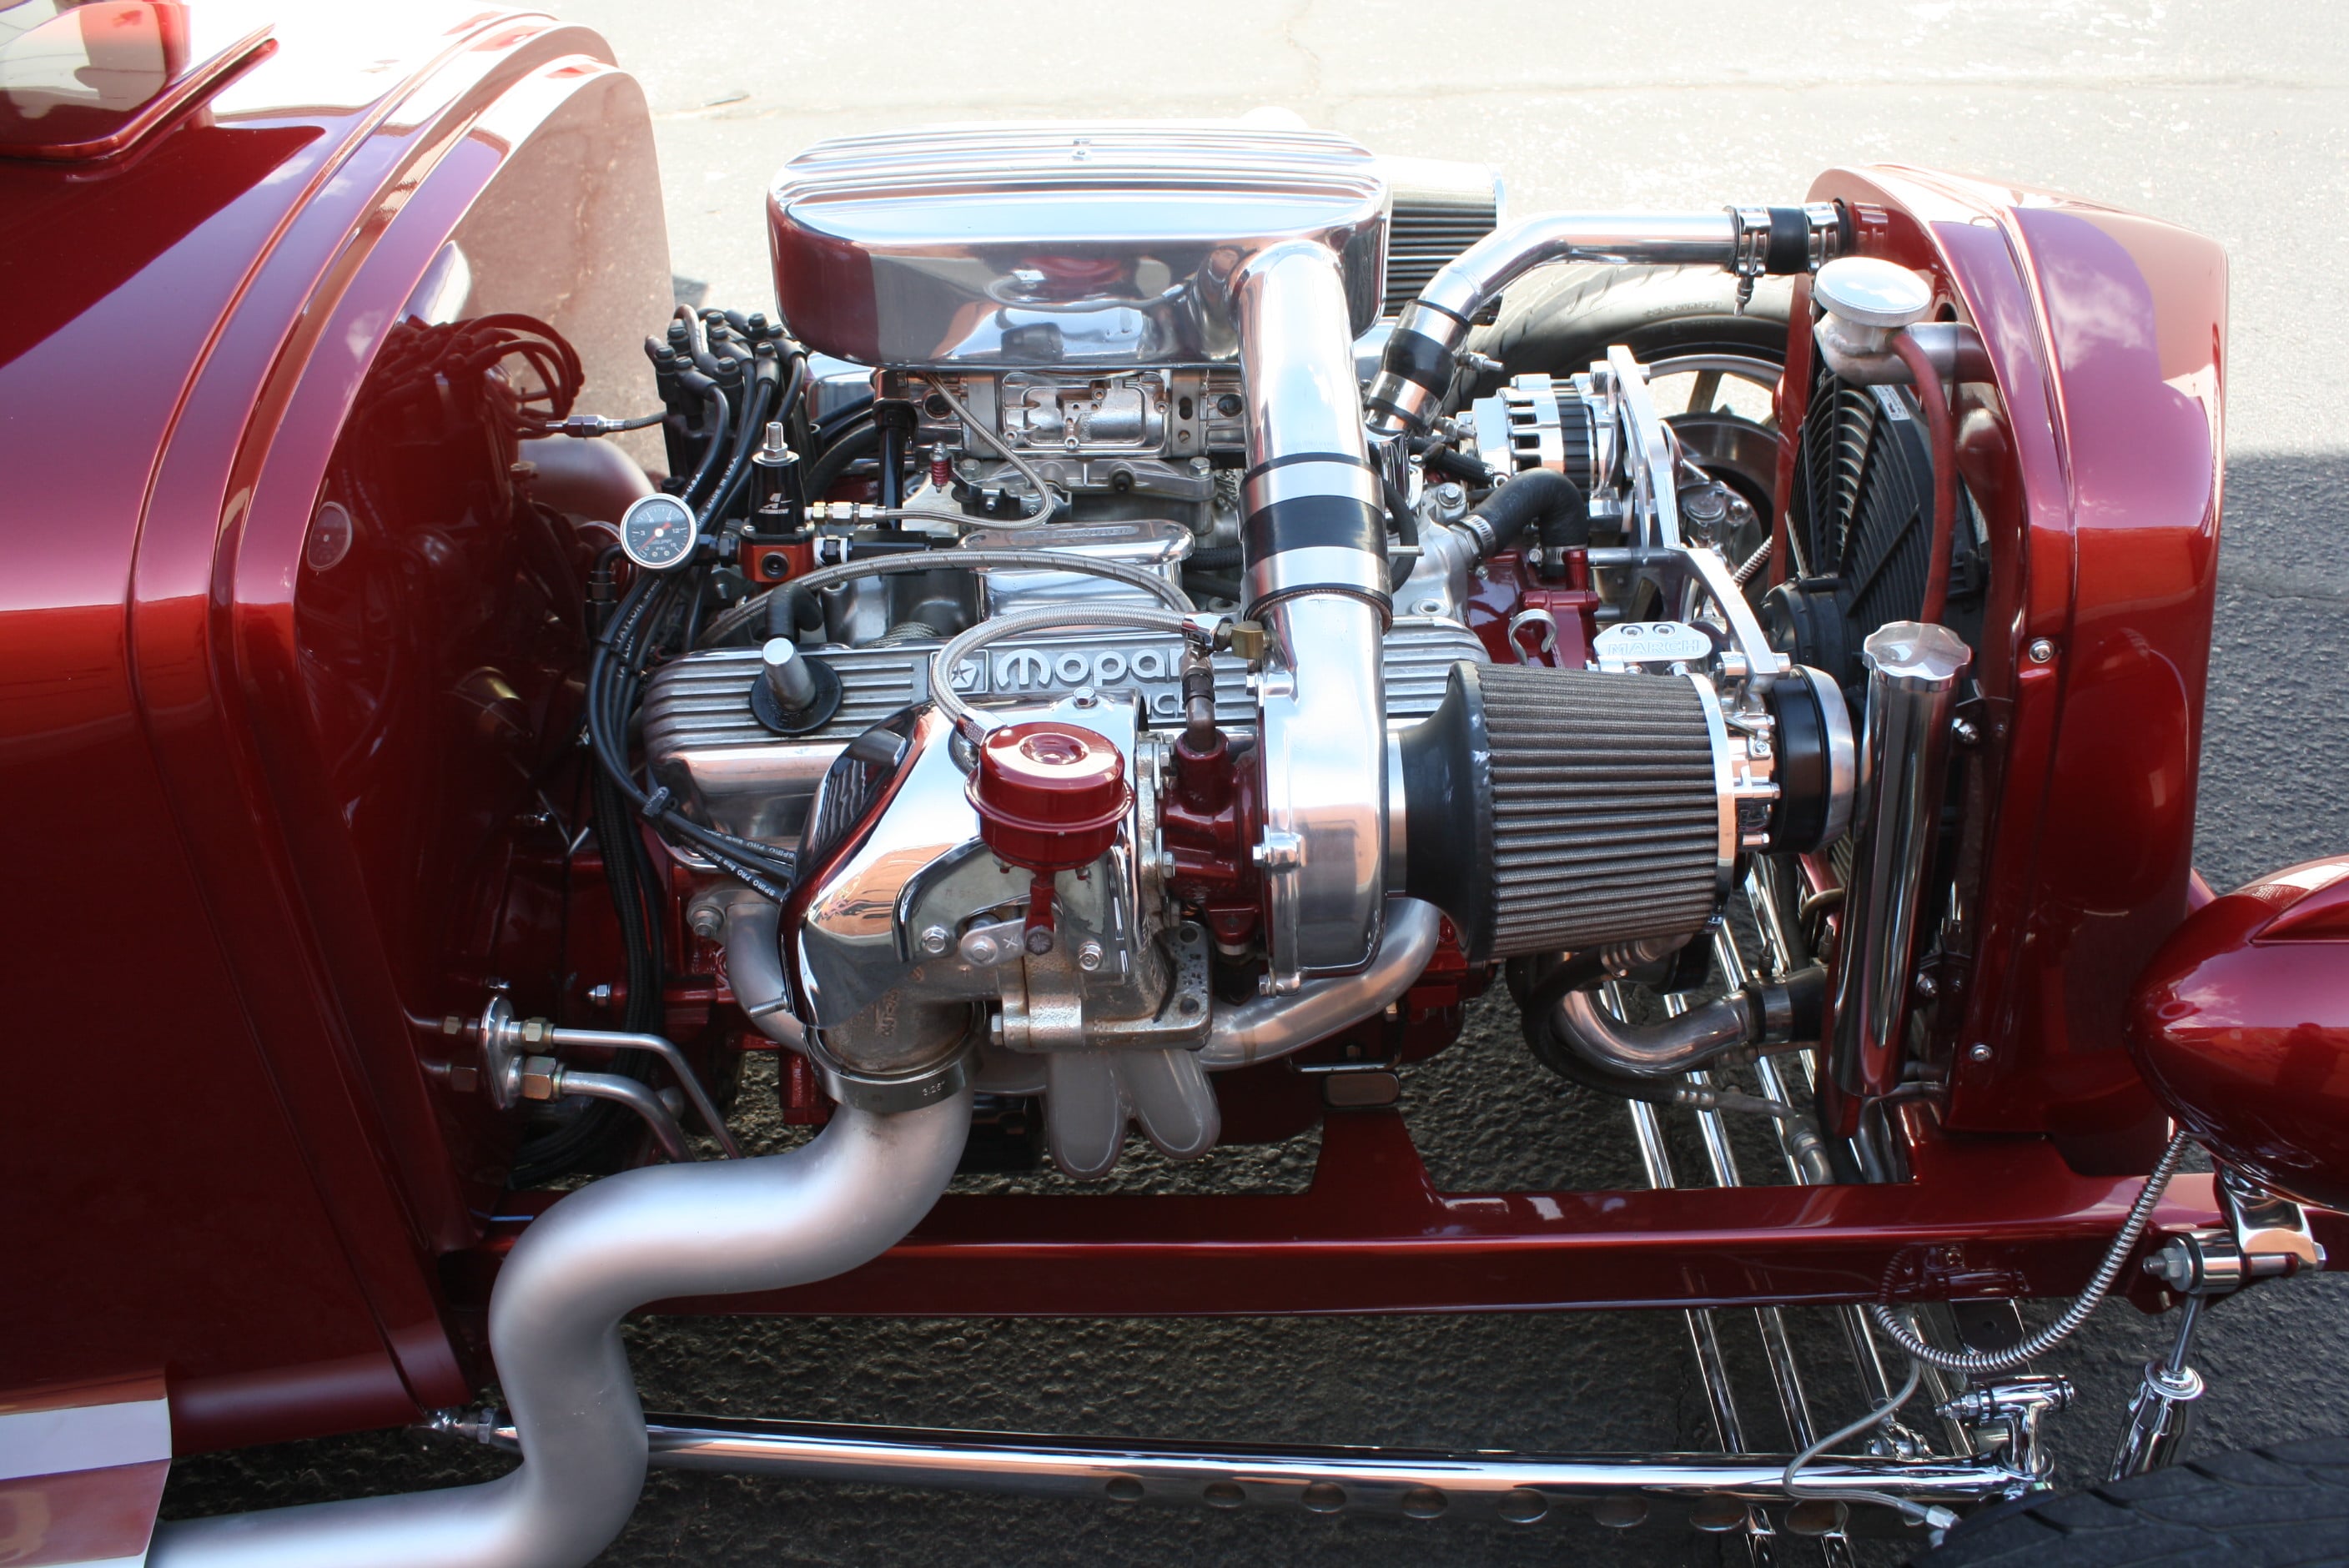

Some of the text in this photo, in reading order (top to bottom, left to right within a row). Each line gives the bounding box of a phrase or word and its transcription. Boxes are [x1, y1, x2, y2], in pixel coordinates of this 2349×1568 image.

[707, 489, 722, 509] MADE
[1608, 640, 1699, 656] MARCH
[737, 868, 752, 882] PRO
[752, 880, 777, 897] SPIRO
